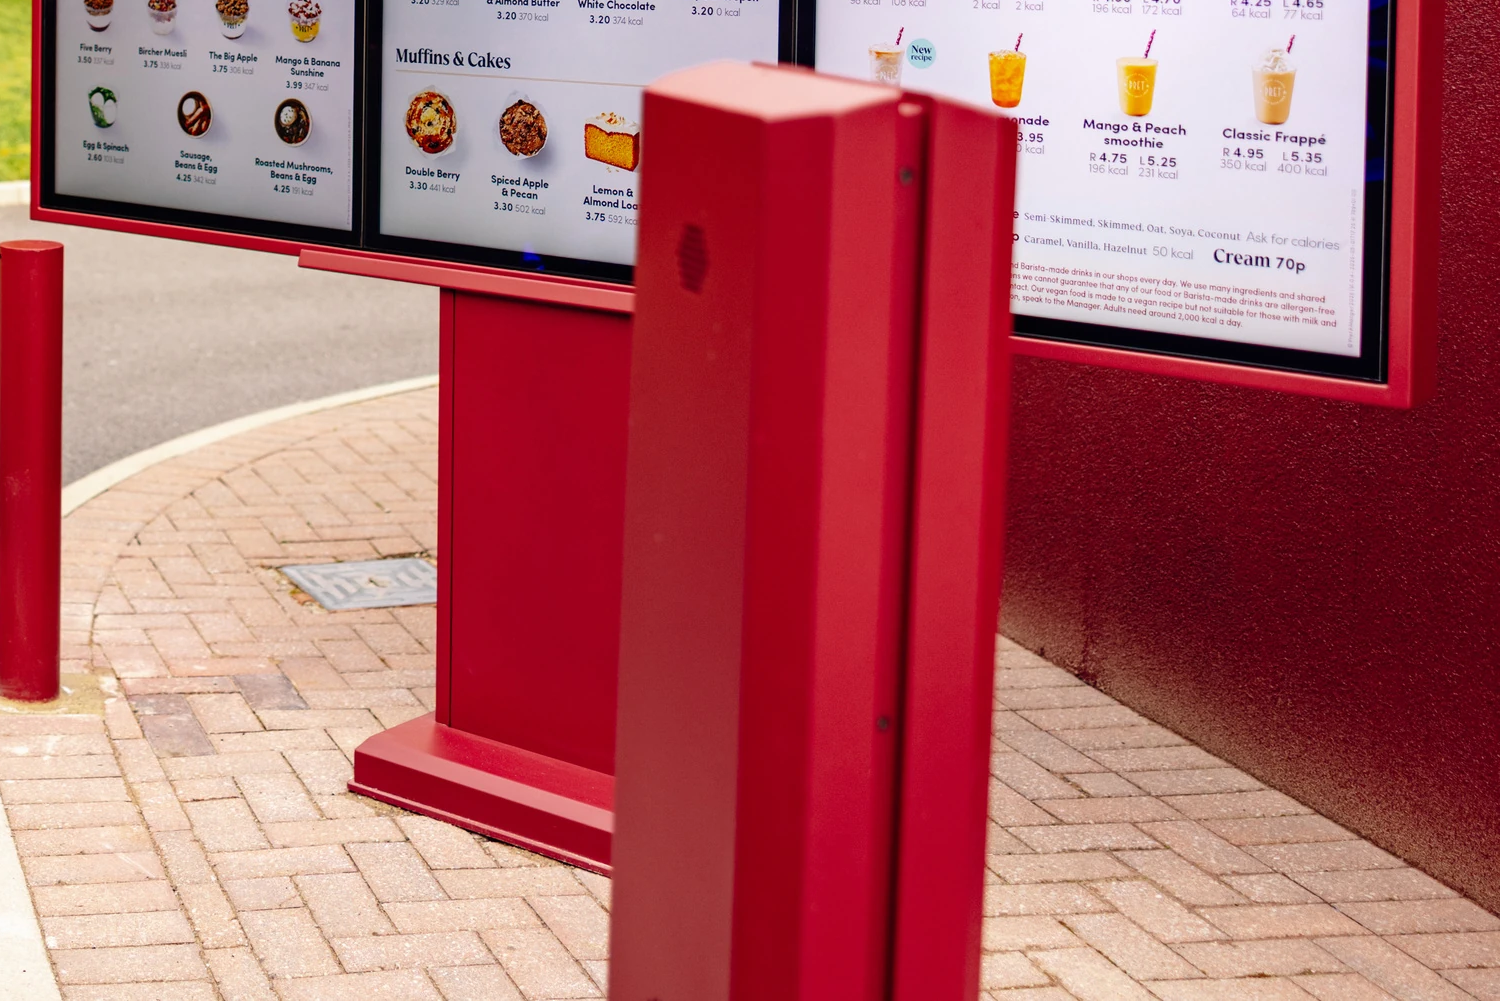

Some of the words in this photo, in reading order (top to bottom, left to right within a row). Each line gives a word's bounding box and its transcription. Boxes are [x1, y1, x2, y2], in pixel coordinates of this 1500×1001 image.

[496, 10, 516, 20] 3.20
[691, 5, 713, 16] 3.20
[716, 7, 722, 16] 0
[724, 7, 740, 16] kcal
[275, 55, 302, 66] Mango
[303, 57, 309, 65] &
[310, 57, 340, 67] Banana
[395, 47, 449, 65] Muffins
[452, 51, 464, 66] &
[467, 51, 510, 69] Cakes
[290, 67, 324, 77] Sunshine
[285, 80, 302, 89] 3.99
[1083, 118, 1128, 134] Mango
[1132, 122, 1141, 132] &
[1145, 122, 1186, 135] Peach
[1103, 137, 1163, 148] smoothie
[1222, 127, 1270, 141] Classic
[1275, 131, 1326, 147] Frappé
[255, 157, 285, 168] Roasted
[286, 161, 333, 174] Mushrooms,
[270, 169, 293, 180] Beans
[294, 172, 300, 181] &
[302, 173, 316, 185] Egg
[491, 174, 520, 186] Spiced
[522, 177, 549, 190] Apple
[273, 184, 290, 193] 4.25
[501, 187, 508, 196] &
[510, 188, 538, 199] Pecan
[493, 201, 513, 211] 3.30
[1213, 248, 1270, 267] Cream
[1276, 257, 1305, 274] 70p
[1022, 295, 1043, 303] speak
[1053, 297, 1065, 305] the
[1066, 298, 1102, 311] Manager.
[1102, 303, 1126, 313] Adults
[1127, 308, 1147, 316] need
[1148, 310, 1176, 319] around
[1177, 312, 1200, 322] 2,000
[1201, 314, 1217, 324] kcal
[1226, 318, 1243, 328] day.
